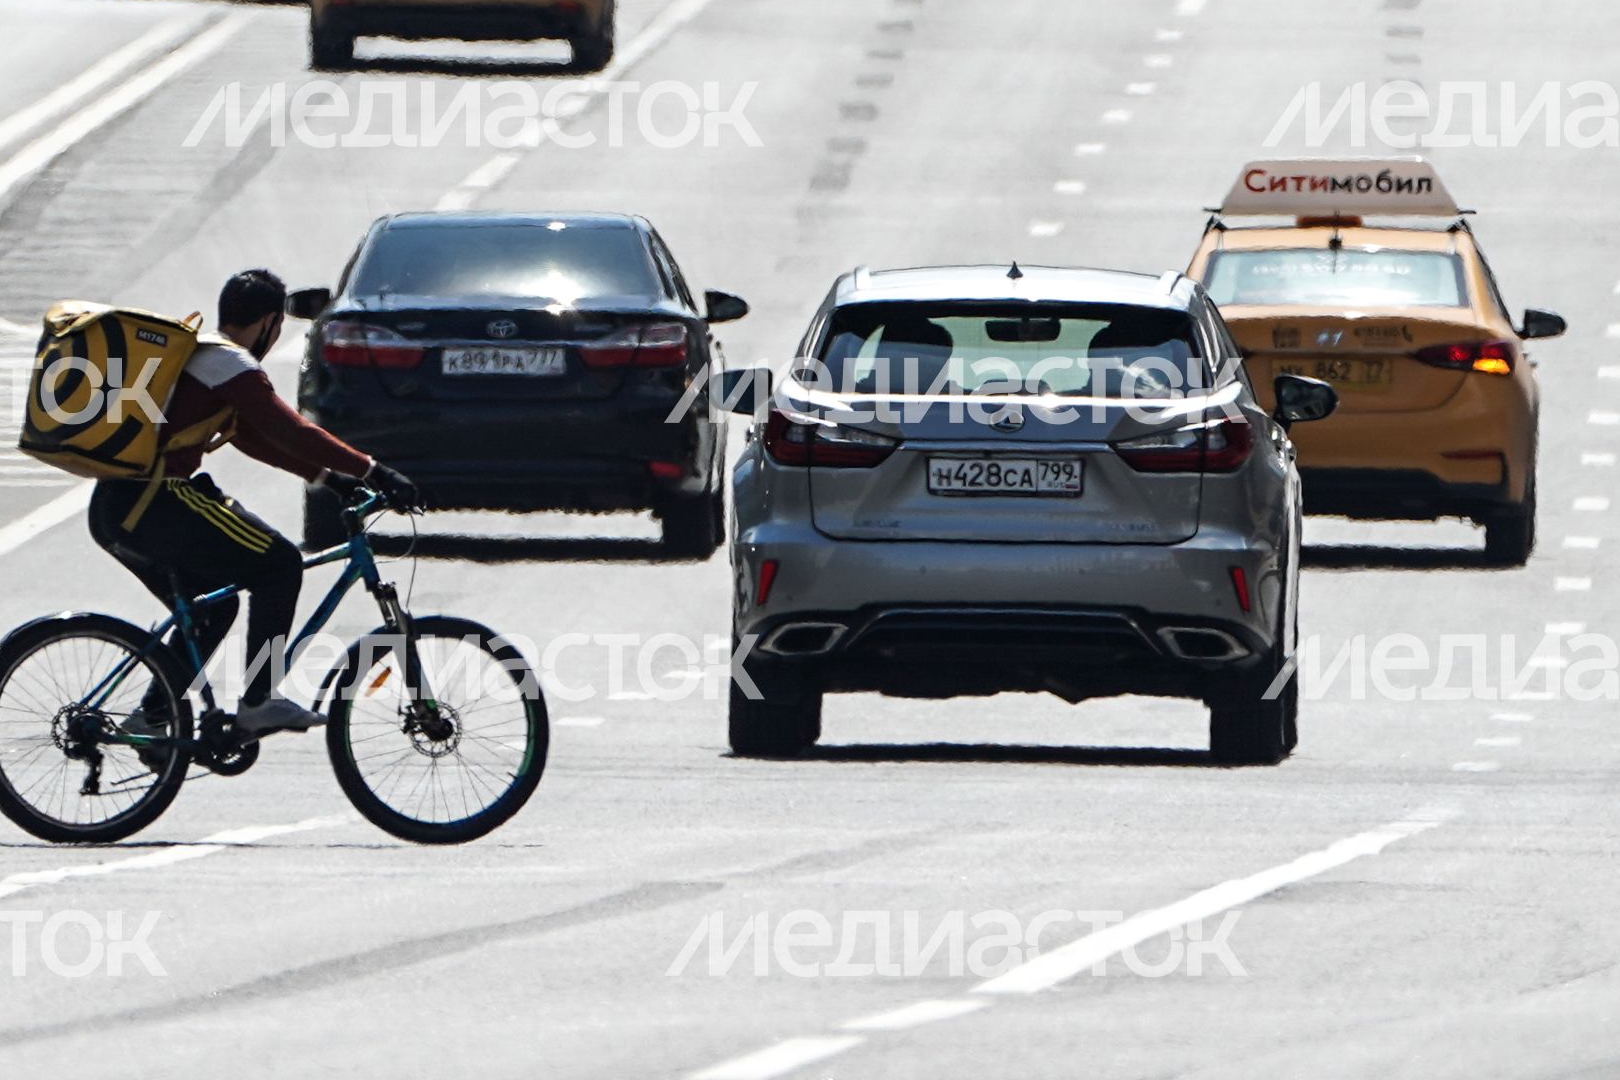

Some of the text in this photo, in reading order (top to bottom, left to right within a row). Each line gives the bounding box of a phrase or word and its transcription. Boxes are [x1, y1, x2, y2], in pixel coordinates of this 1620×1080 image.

[1244, 168, 1434, 193] Ситимобил
[937, 463, 1074, 488] Н428СА 799
